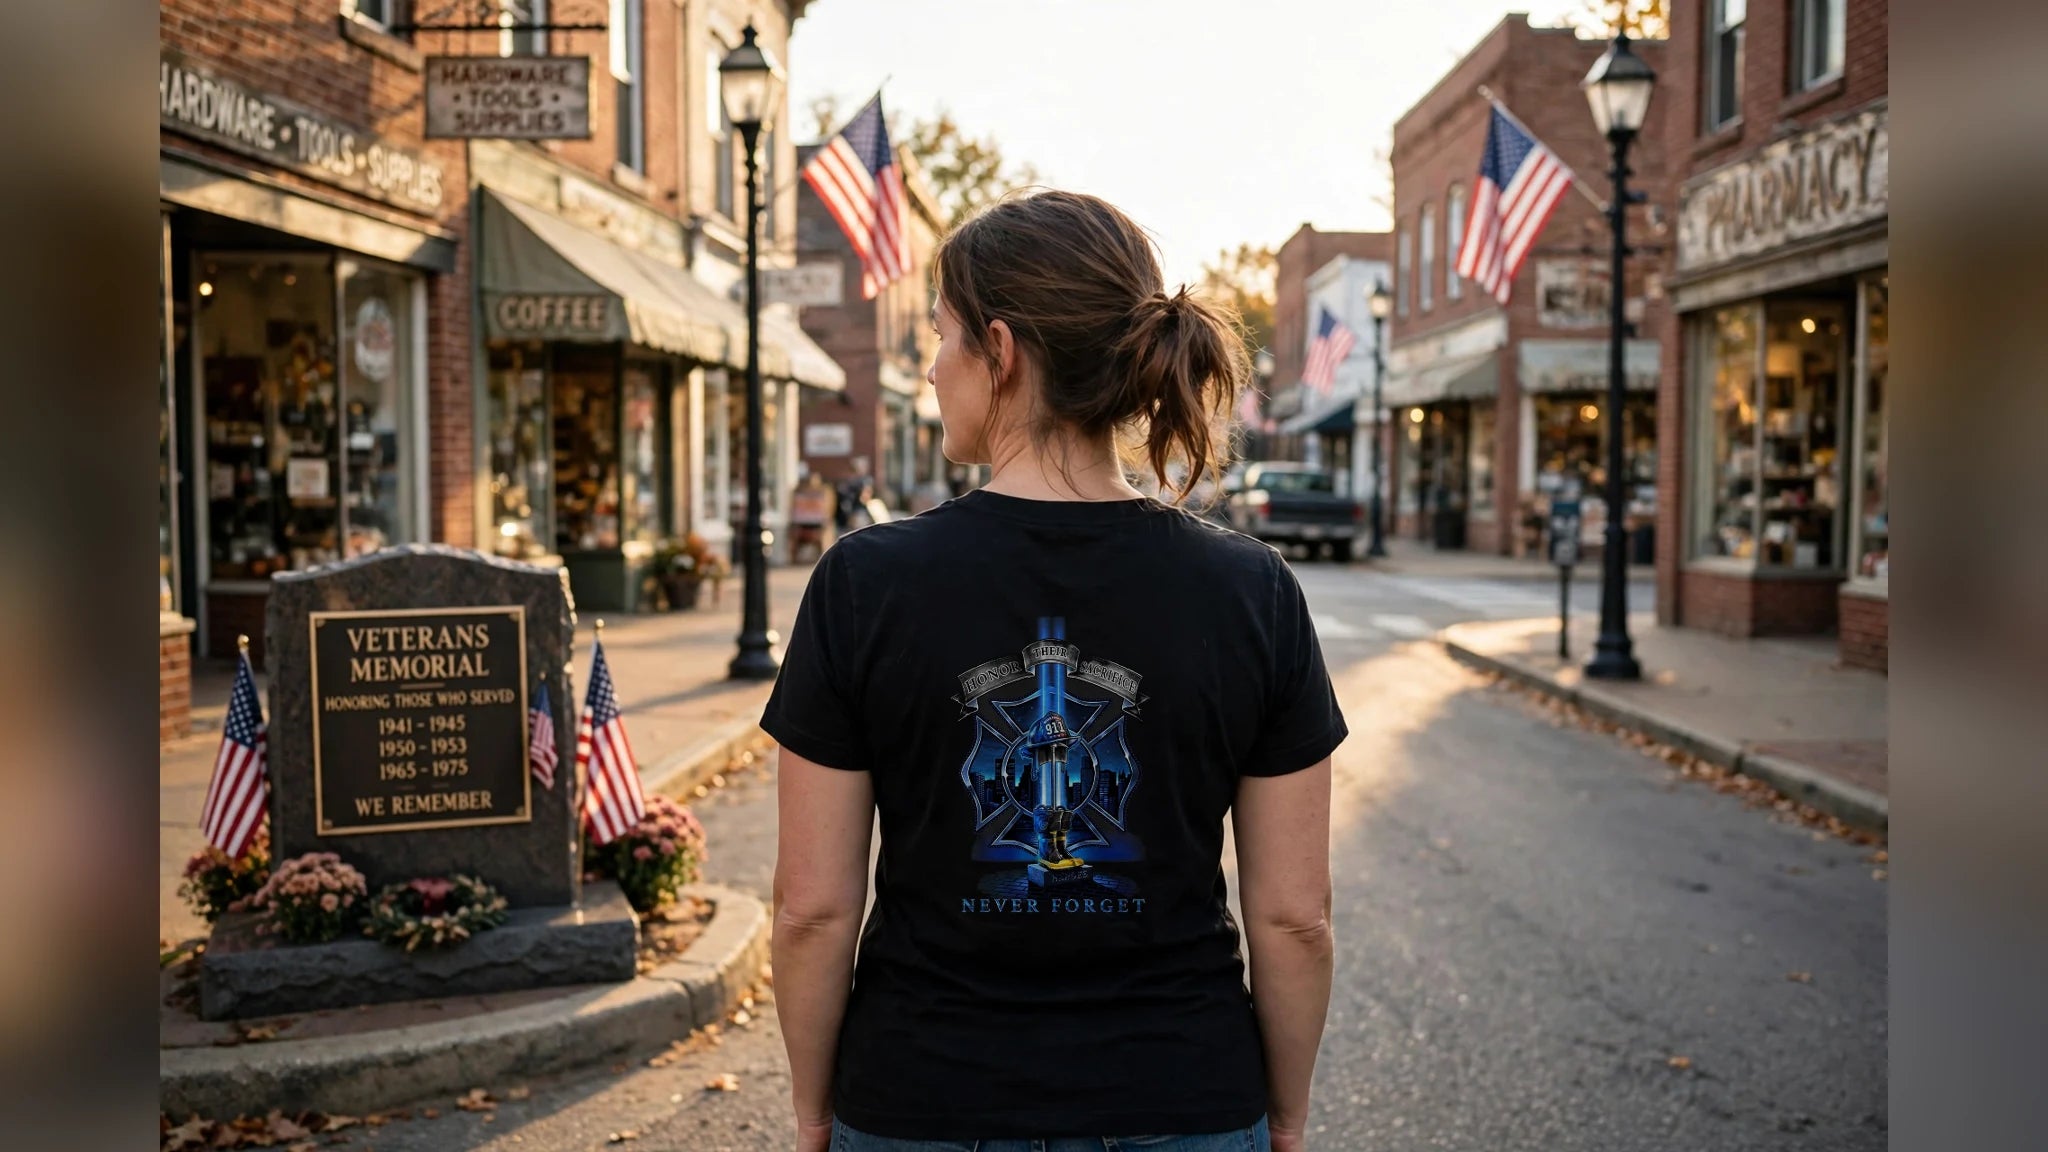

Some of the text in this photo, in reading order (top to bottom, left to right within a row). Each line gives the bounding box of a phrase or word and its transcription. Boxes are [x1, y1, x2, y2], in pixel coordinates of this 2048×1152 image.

[442, 63, 571, 86] HARDWARE
[468, 87, 542, 109] TOOLS
[455, 110, 565, 132] SUPPLIES
[295, 116, 355, 177] TOOLS
[1705, 127, 1877, 251] PHARMACY
[499, 296, 605, 330] COFFEE
[347, 624, 490, 652] VETERANS
[350, 653, 490, 682] MEMORIAL
[965, 645, 1137, 695] HONOR THEIR SACRIFICE
[325, 688, 515, 711] HONORING THOSE WHO SERVED
[379, 718, 412, 735] 1941
[429, 714, 466, 732] 1945
[1045, 721, 1065, 735] 911
[379, 740, 416, 758] 1950
[431, 737, 467, 755] 1953
[380, 762, 416, 780] 1965
[432, 759, 468, 777] 1975
[355, 791, 493, 817] WE REMEMBER
[961, 898, 1146, 913] NEVER FORGET
